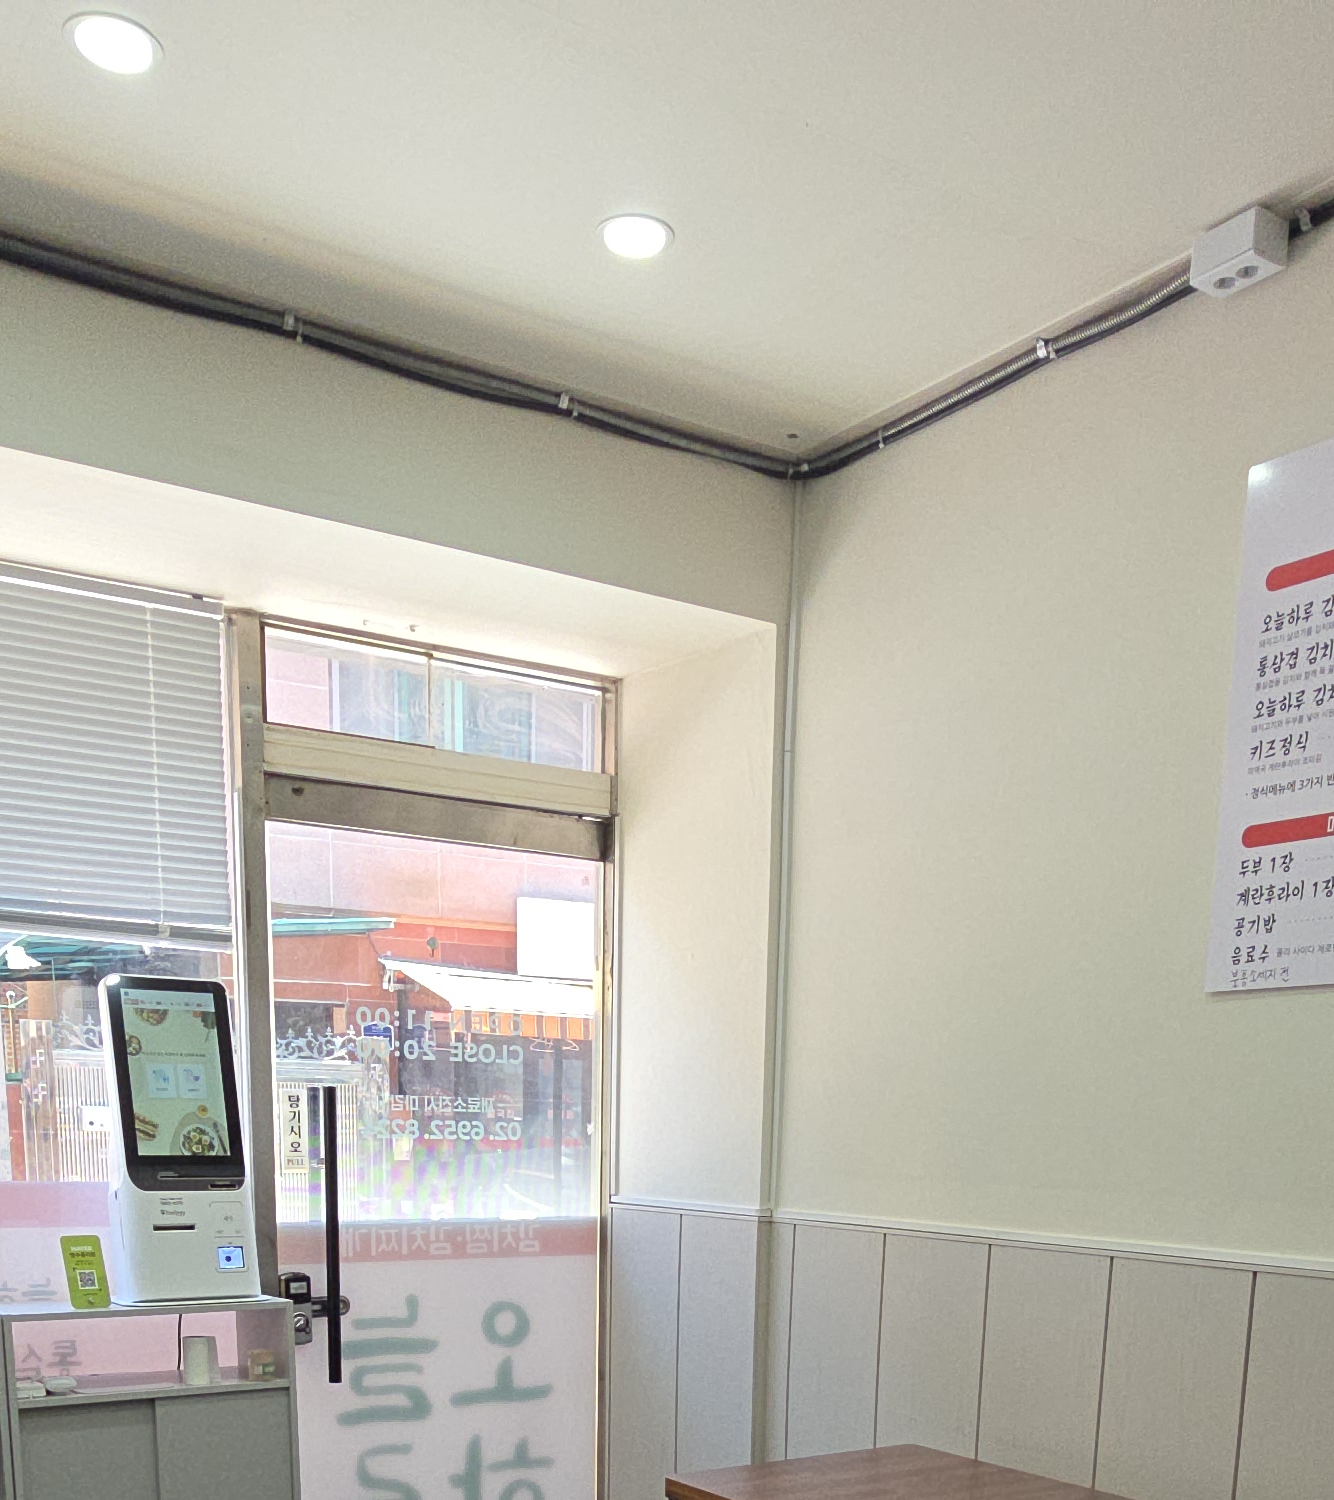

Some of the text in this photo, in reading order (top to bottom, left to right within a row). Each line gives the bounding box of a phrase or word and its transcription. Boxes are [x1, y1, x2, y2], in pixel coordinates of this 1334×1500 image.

[1261, 600, 1314, 633] 오늘하루
[1257, 647, 1299, 677] 통삼겹
[1253, 689, 1305, 719] 오늘하루
[1250, 731, 1309, 762] 키즈정식
[1299, 776, 1323, 790] 3가지
[1239, 855, 1263, 878] 두부
[1270, 851, 1294, 874] 1장
[1236, 880, 1305, 907] 계란후라이
[1233, 914, 1276, 937] 공기밥
[1231, 945, 1269, 966] 음료수
[287, 1094, 303, 1153] 당기시오
